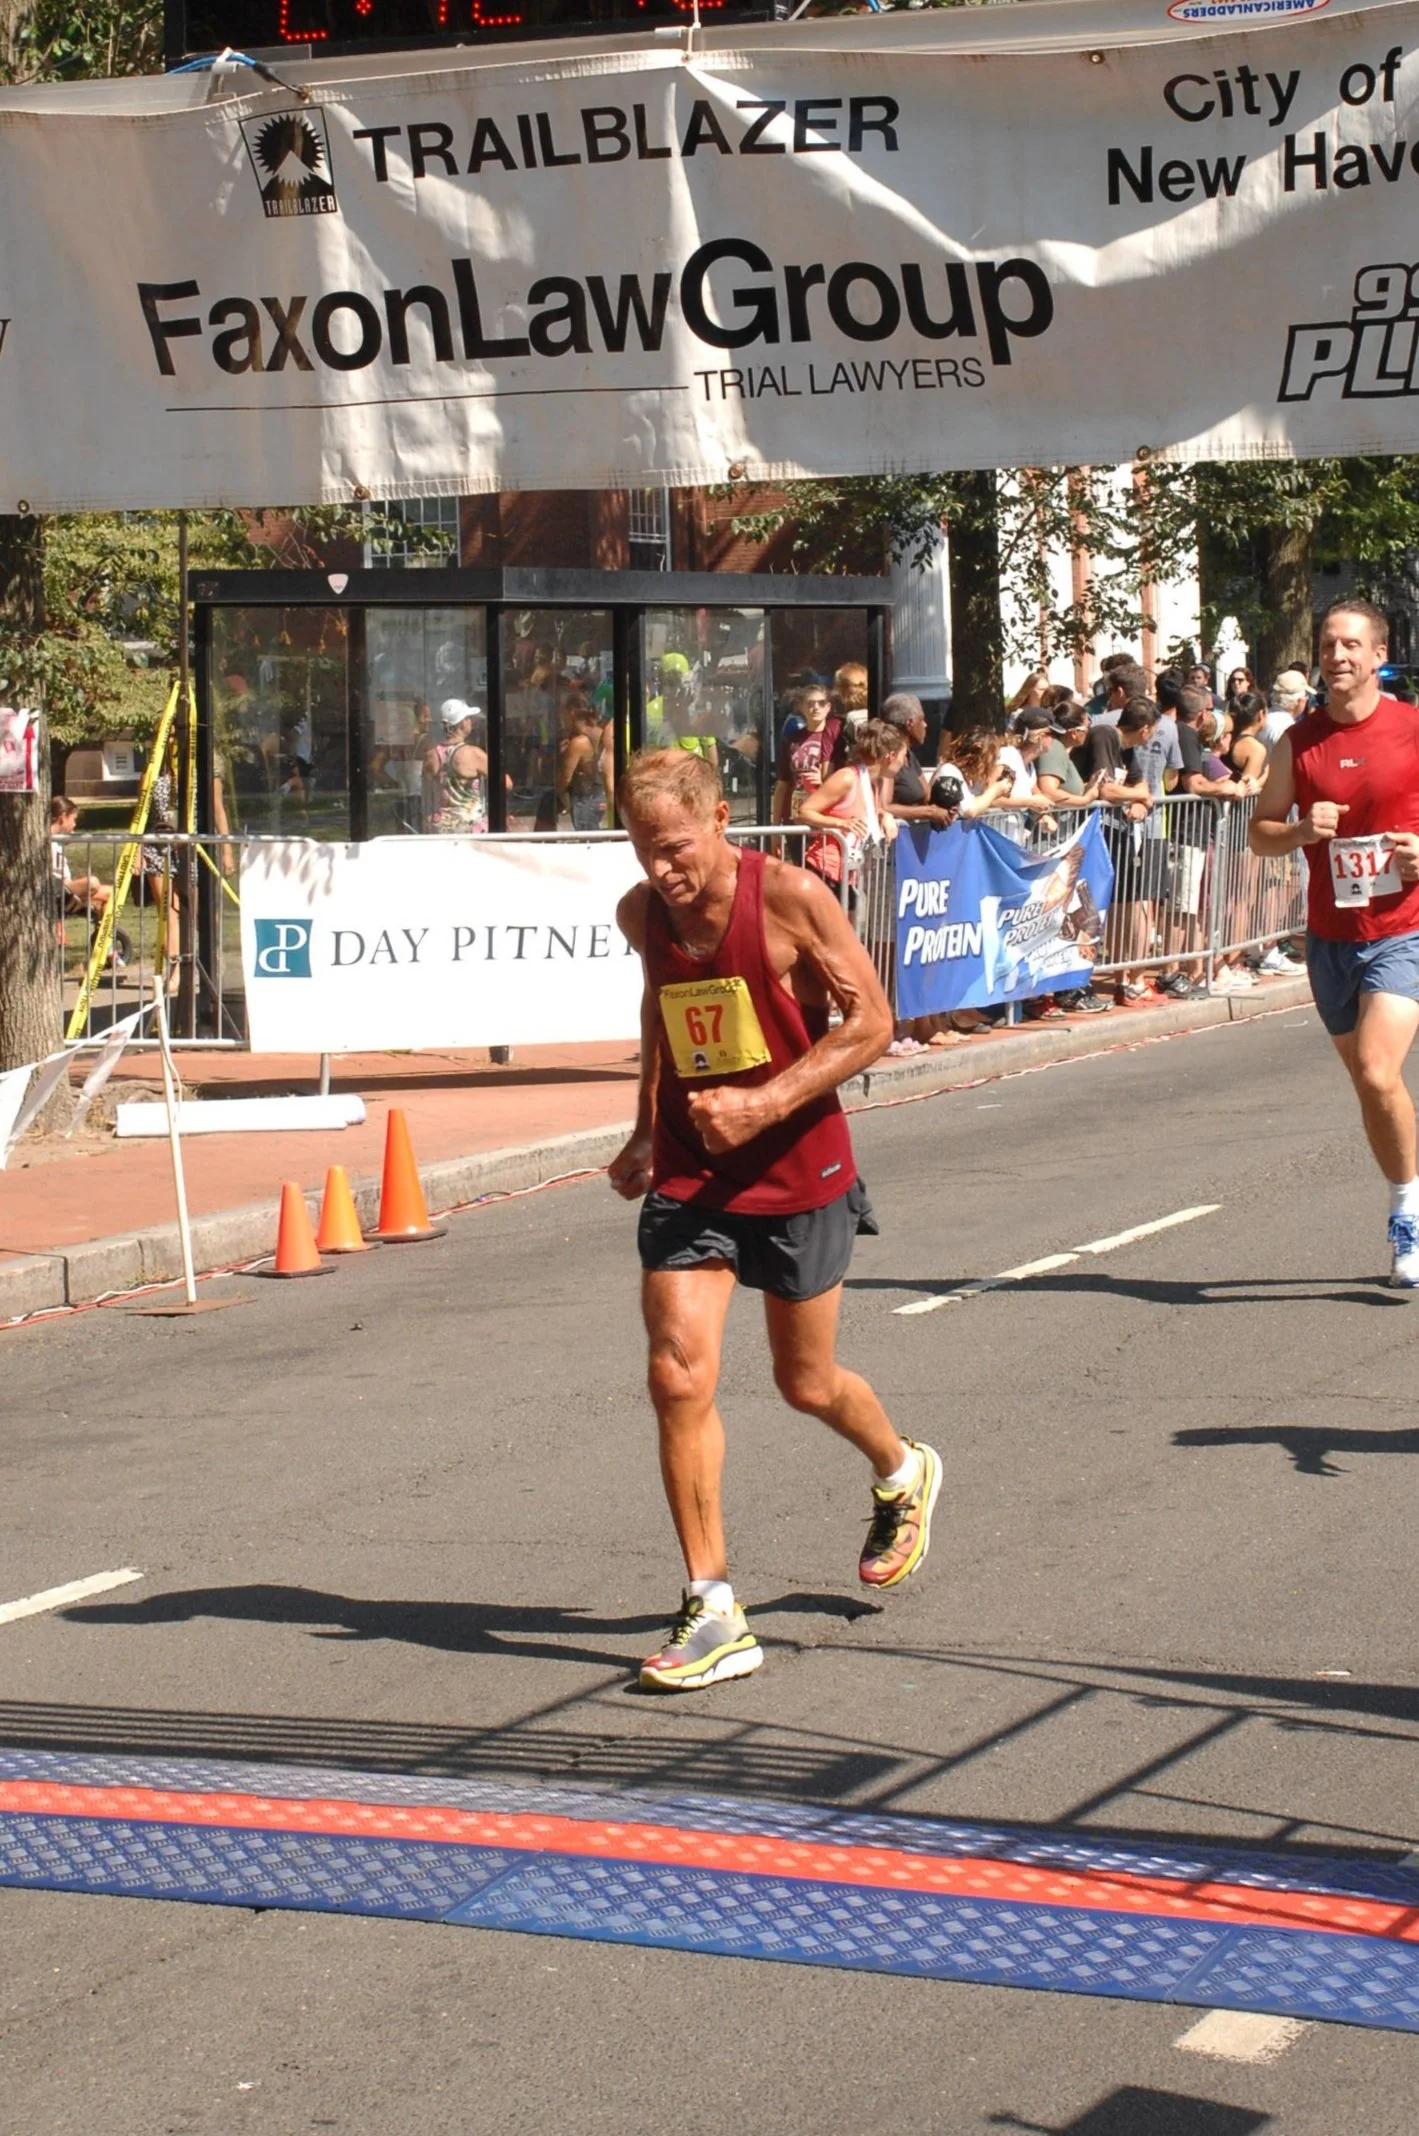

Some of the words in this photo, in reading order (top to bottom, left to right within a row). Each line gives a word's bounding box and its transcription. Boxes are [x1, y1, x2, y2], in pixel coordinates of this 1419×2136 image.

[1163, 65, 1301, 127] City
[1340, 46, 1403, 106] of
[353, 95, 900, 182] TRAILBLAZER
[1107, 146, 1247, 205] New
[137, 237, 1054, 375] FaxonLawGroup
[694, 365, 802, 401] TRIAL
[809, 357, 985, 396] LAWYERS
[1277, 320, 1419, 402] PL
[1334, 848, 1395, 879] 1317
[898, 878, 951, 919] PURE
[331, 926, 430, 966] DAY
[903, 922, 984, 966] PROTEIN
[685, 1004, 723, 1046] 67
